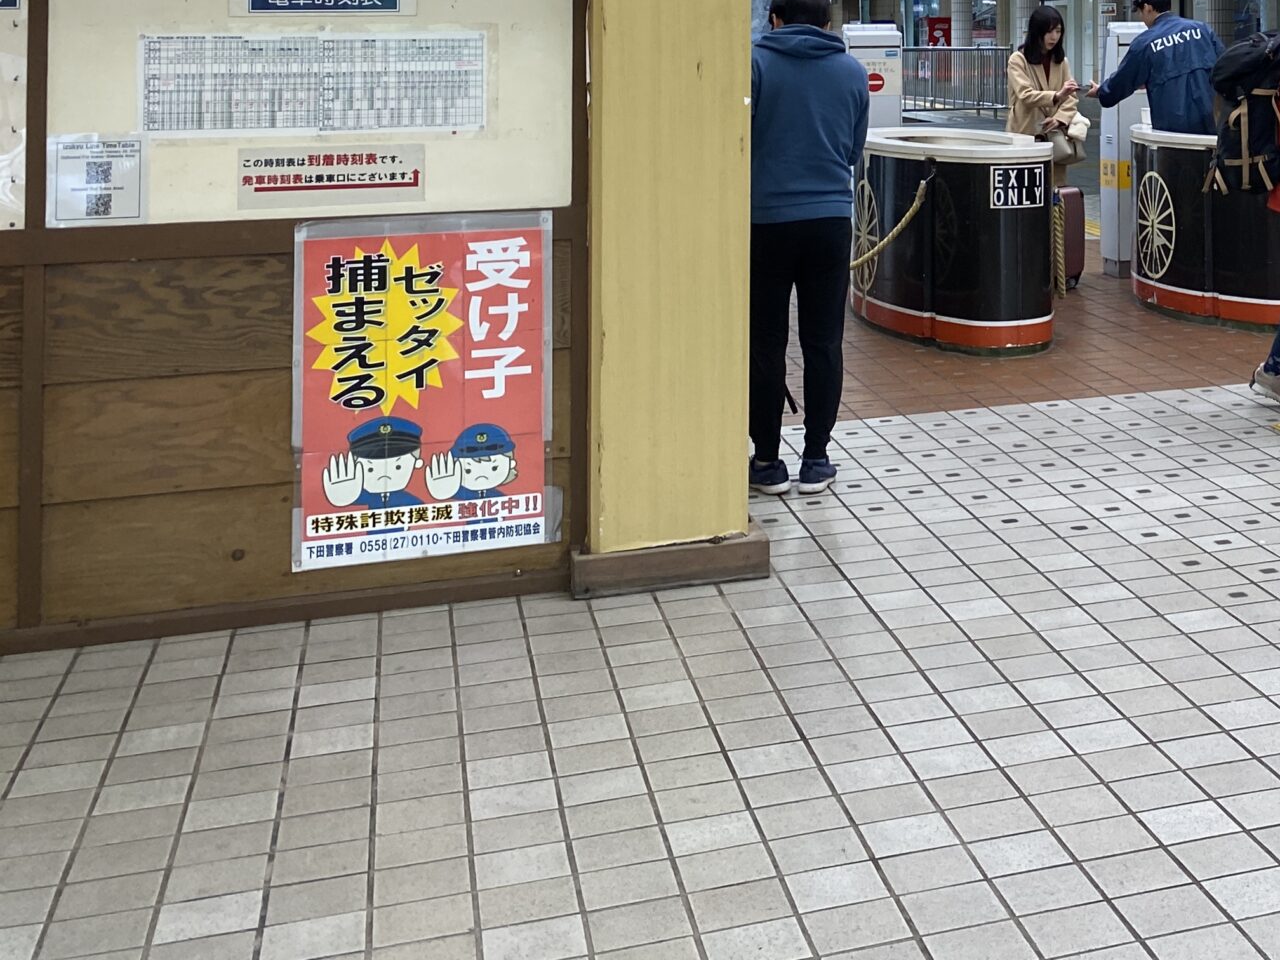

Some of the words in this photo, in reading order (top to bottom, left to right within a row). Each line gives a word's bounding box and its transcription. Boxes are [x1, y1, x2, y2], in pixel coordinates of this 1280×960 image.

[1150, 28, 1202, 53] IZUKYU
[242, 153, 403, 168] この時刻表は到着時刻表です。
[994, 168, 1041, 187] EXIT
[993, 186, 1041, 206] ONLY
[325, 253, 390, 409] 捕まえる
[393, 264, 445, 390] ゼッタイ
[465, 236, 532, 399] 受け子
[311, 504, 453, 533] 特殊詐欺撲滅
